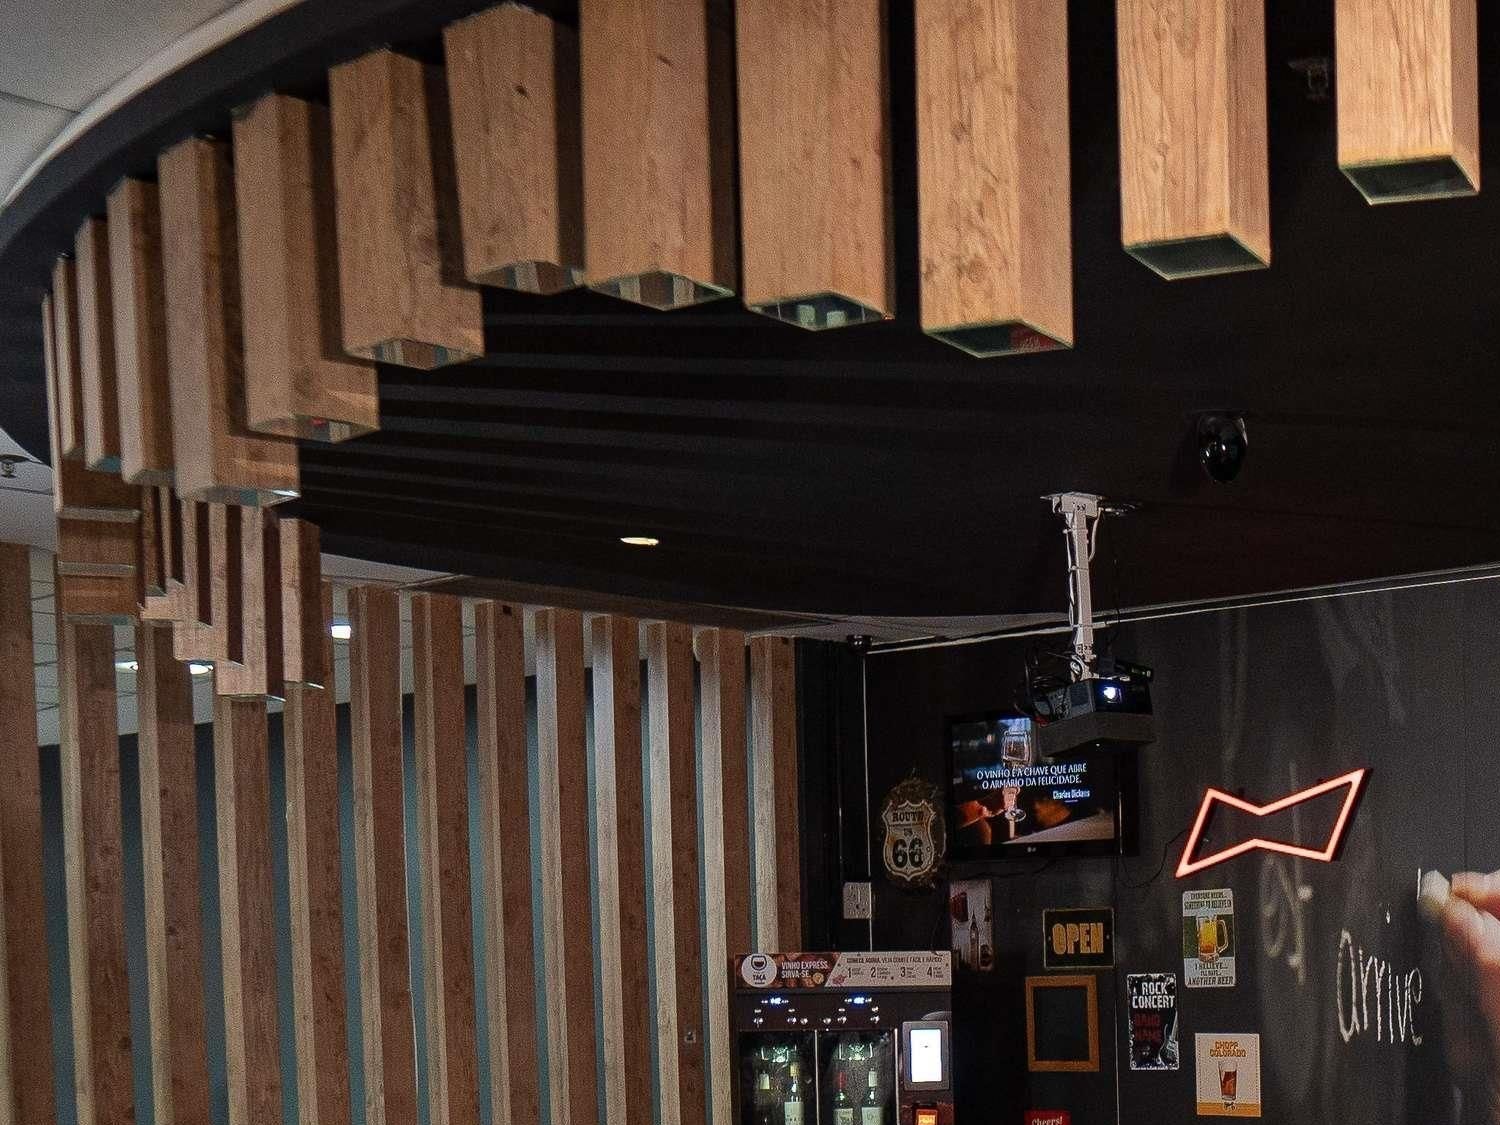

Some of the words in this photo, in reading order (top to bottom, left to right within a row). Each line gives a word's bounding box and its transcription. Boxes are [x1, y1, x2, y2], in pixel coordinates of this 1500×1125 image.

[977, 770, 984, 780] O
[984, 768, 1010, 779] VINHO
[1023, 765, 1049, 776] CHAVE
[1050, 764, 1067, 775] QUE
[1068, 763, 1087, 773] ABRE
[982, 780, 989, 789] O
[1026, 777, 1036, 787] DA
[1052, 790, 1071, 800] Charles
[1071, 789, 1090, 799] Dickens
[892, 838, 924, 868] 66
[1052, 922, 1104, 955] OPEN
[781, 961, 800, 970] VINHO
[871, 967, 876, 978] 2
[900, 967, 906, 977] 3
[927, 966, 932, 977] 4
[1141, 981, 1168, 995] ROCK
[1187, 977, 1216, 986] ANOTHER
[1218, 976, 1233, 985] BEER
[1337, 927, 1423, 1046] arrive
[1132, 995, 1175, 1009] CONCERT
